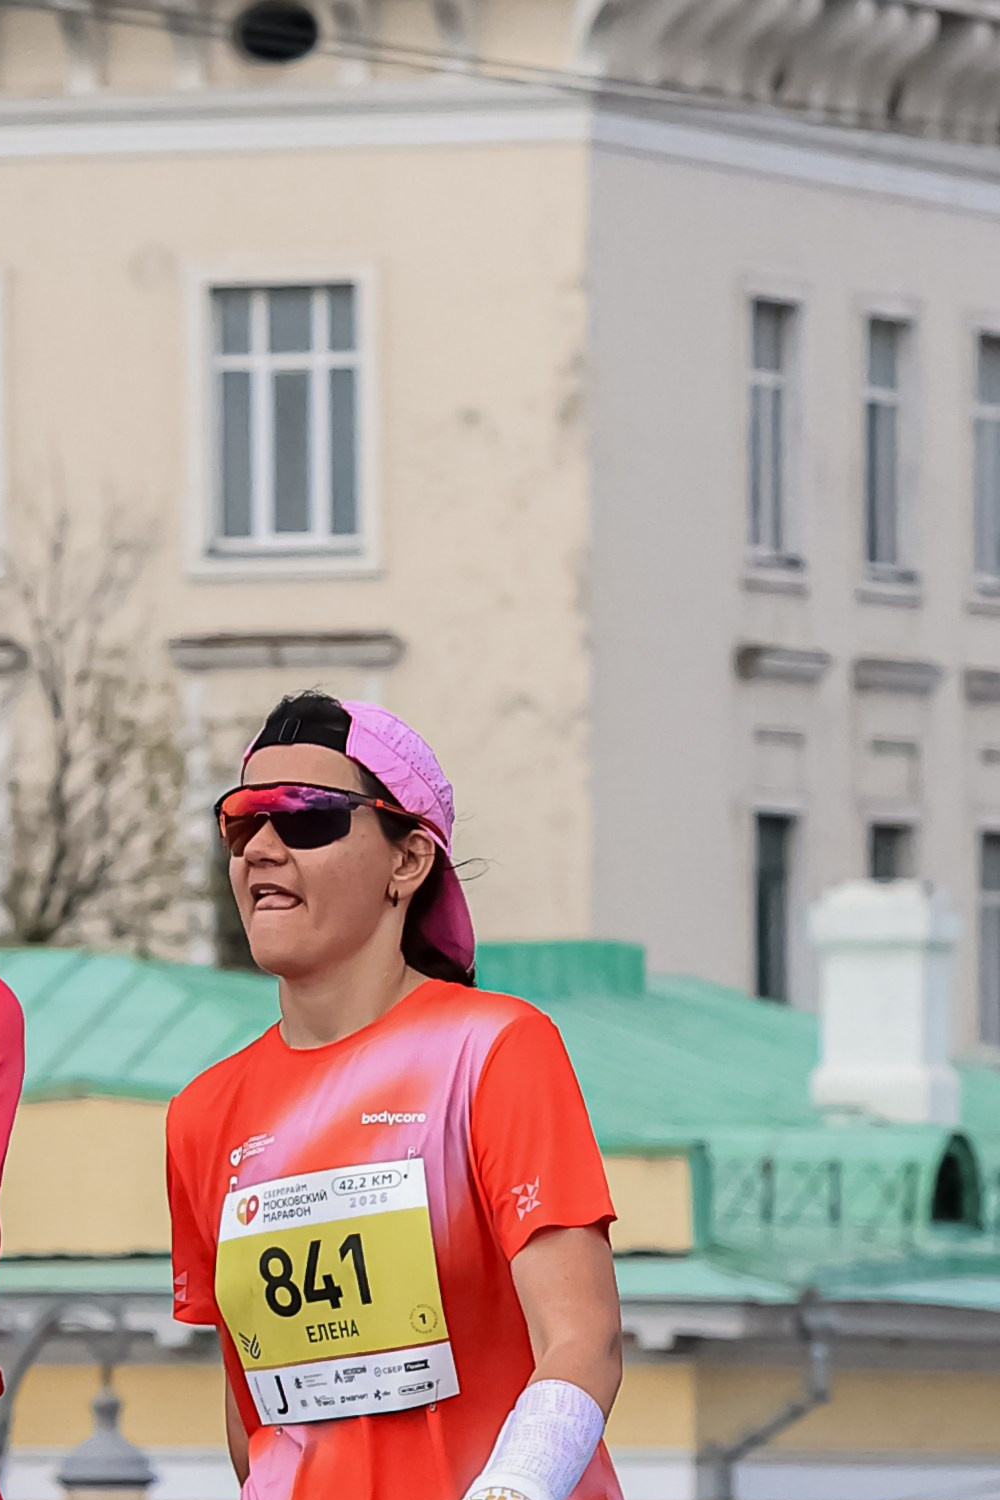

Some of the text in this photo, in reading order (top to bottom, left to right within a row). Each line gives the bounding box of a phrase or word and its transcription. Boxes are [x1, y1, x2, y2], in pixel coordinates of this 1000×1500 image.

[361, 1110, 426, 1126] bodycore
[339, 1174, 393, 1191] 42,2 КМ
[263, 1184, 307, 1199] СБЕРПРАЙМ
[263, 1189, 328, 1211] МОСКОВСКИЙ
[349, 1192, 388, 1208] 2026
[263, 1206, 311, 1223] МАРАФОН
[259, 1233, 373, 1318] 841
[419, 1313, 426, 1324] 1
[305, 1319, 360, 1344] ЕЛЕНА
[274, 1375, 289, 1415] J
